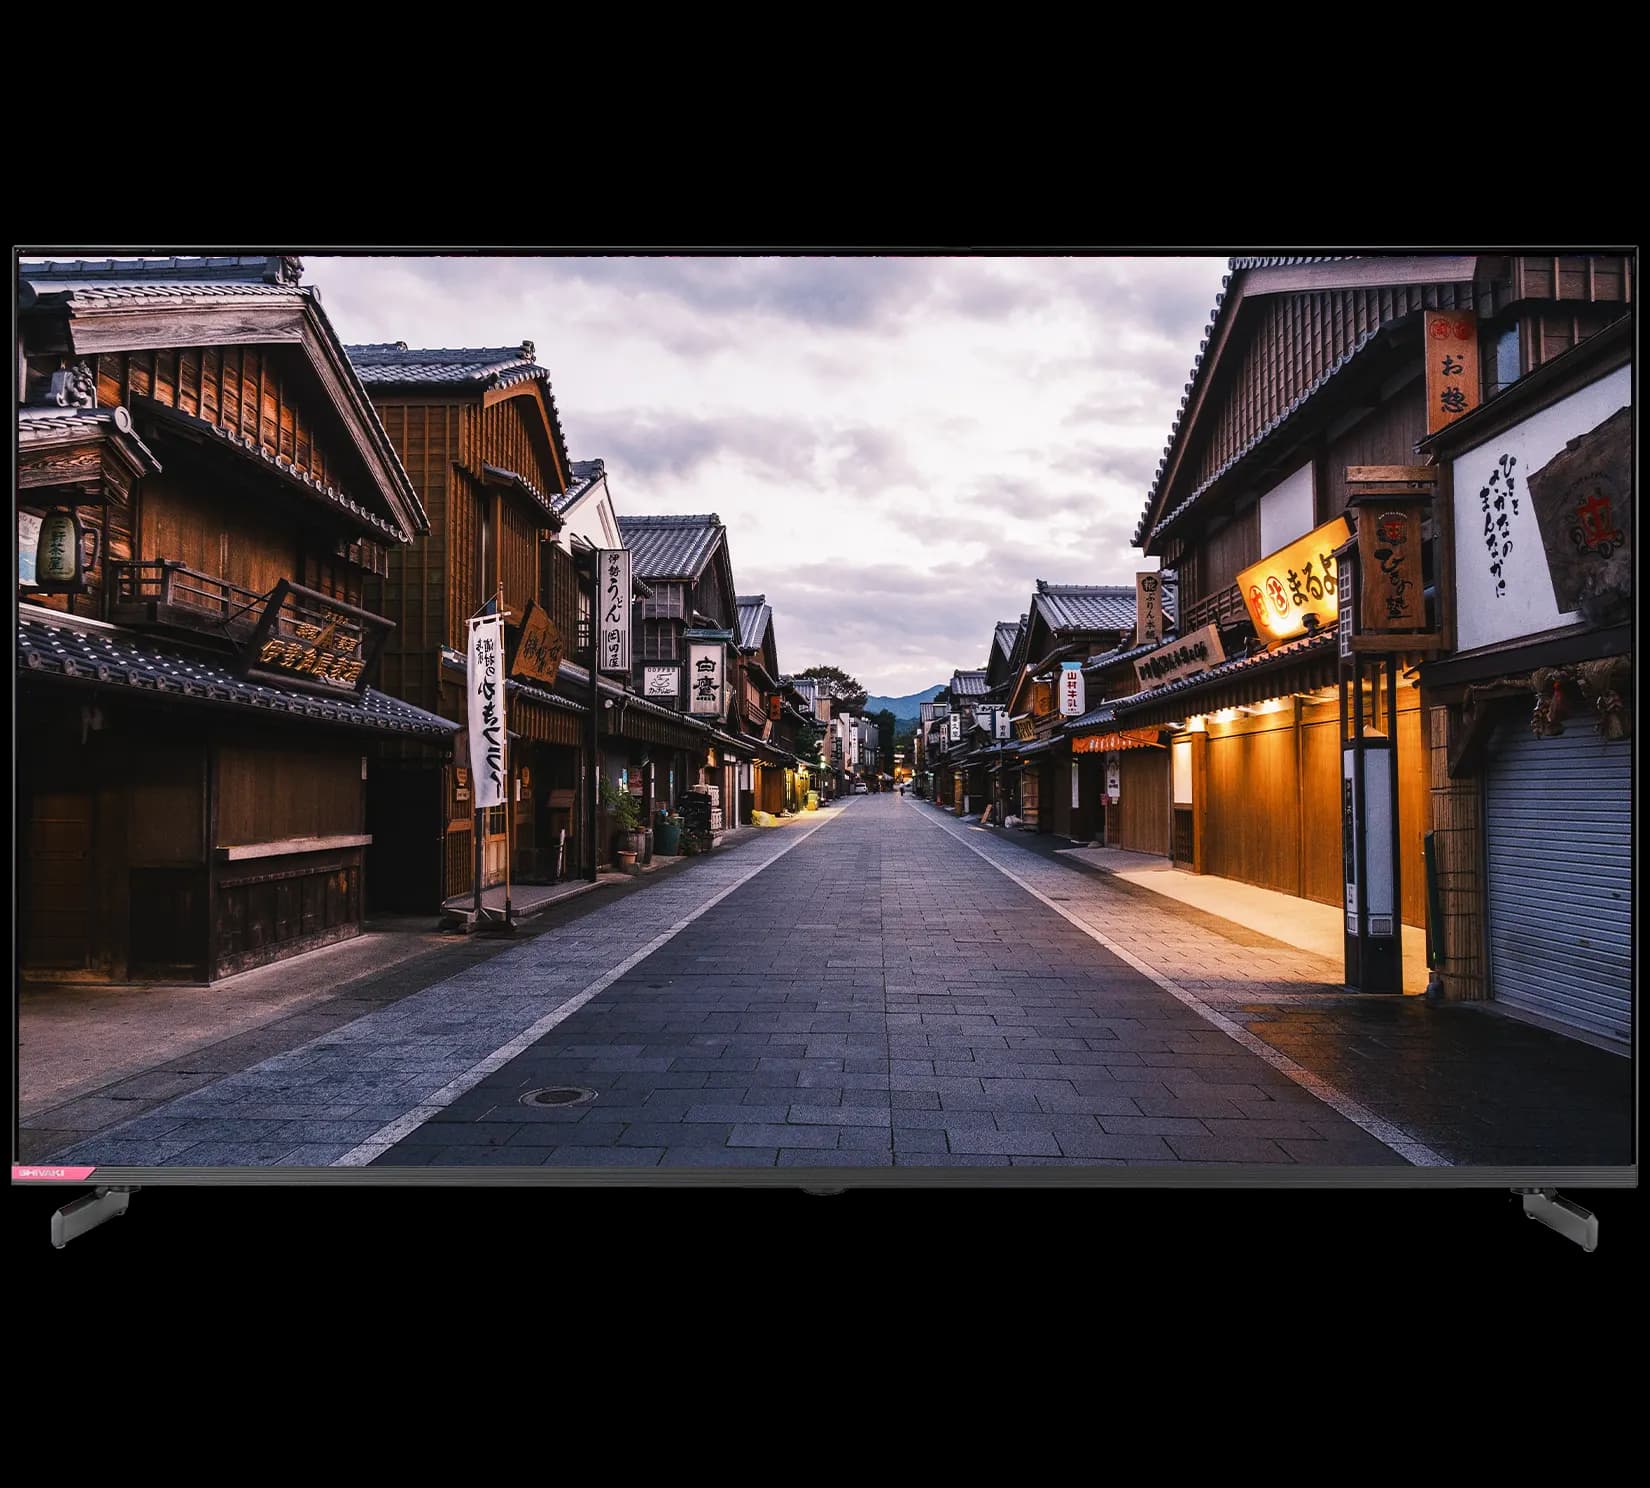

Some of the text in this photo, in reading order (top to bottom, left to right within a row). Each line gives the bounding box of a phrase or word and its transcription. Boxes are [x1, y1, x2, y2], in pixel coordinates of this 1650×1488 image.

[605, 554, 623, 623] 伊勢うどん
[1067, 672, 1077, 707] 山村牛乳
